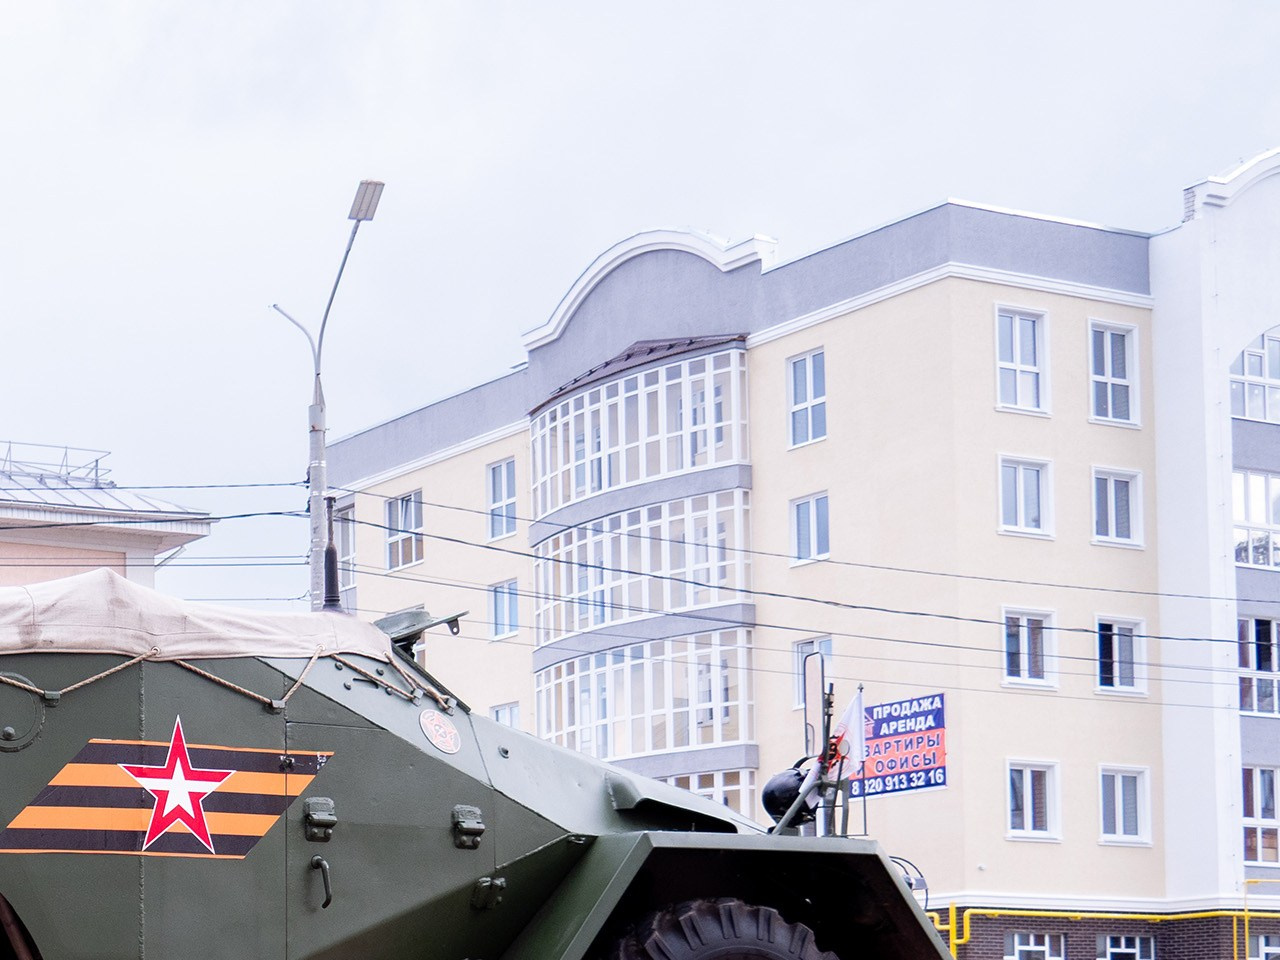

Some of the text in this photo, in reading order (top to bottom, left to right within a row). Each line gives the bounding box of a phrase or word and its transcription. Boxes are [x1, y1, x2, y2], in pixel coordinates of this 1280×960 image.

[873, 696, 942, 719] ПРОДАЖА
[880, 714, 935, 735] АРЕНДА
[865, 734, 940, 757] ВАРТИРЫ
[875, 752, 936, 773] ОФИСЫ
[851, 781, 860, 796] 8
[885, 773, 907, 790] 913
[910, 771, 925, 786] 32
[928, 769, 944, 784] 16
